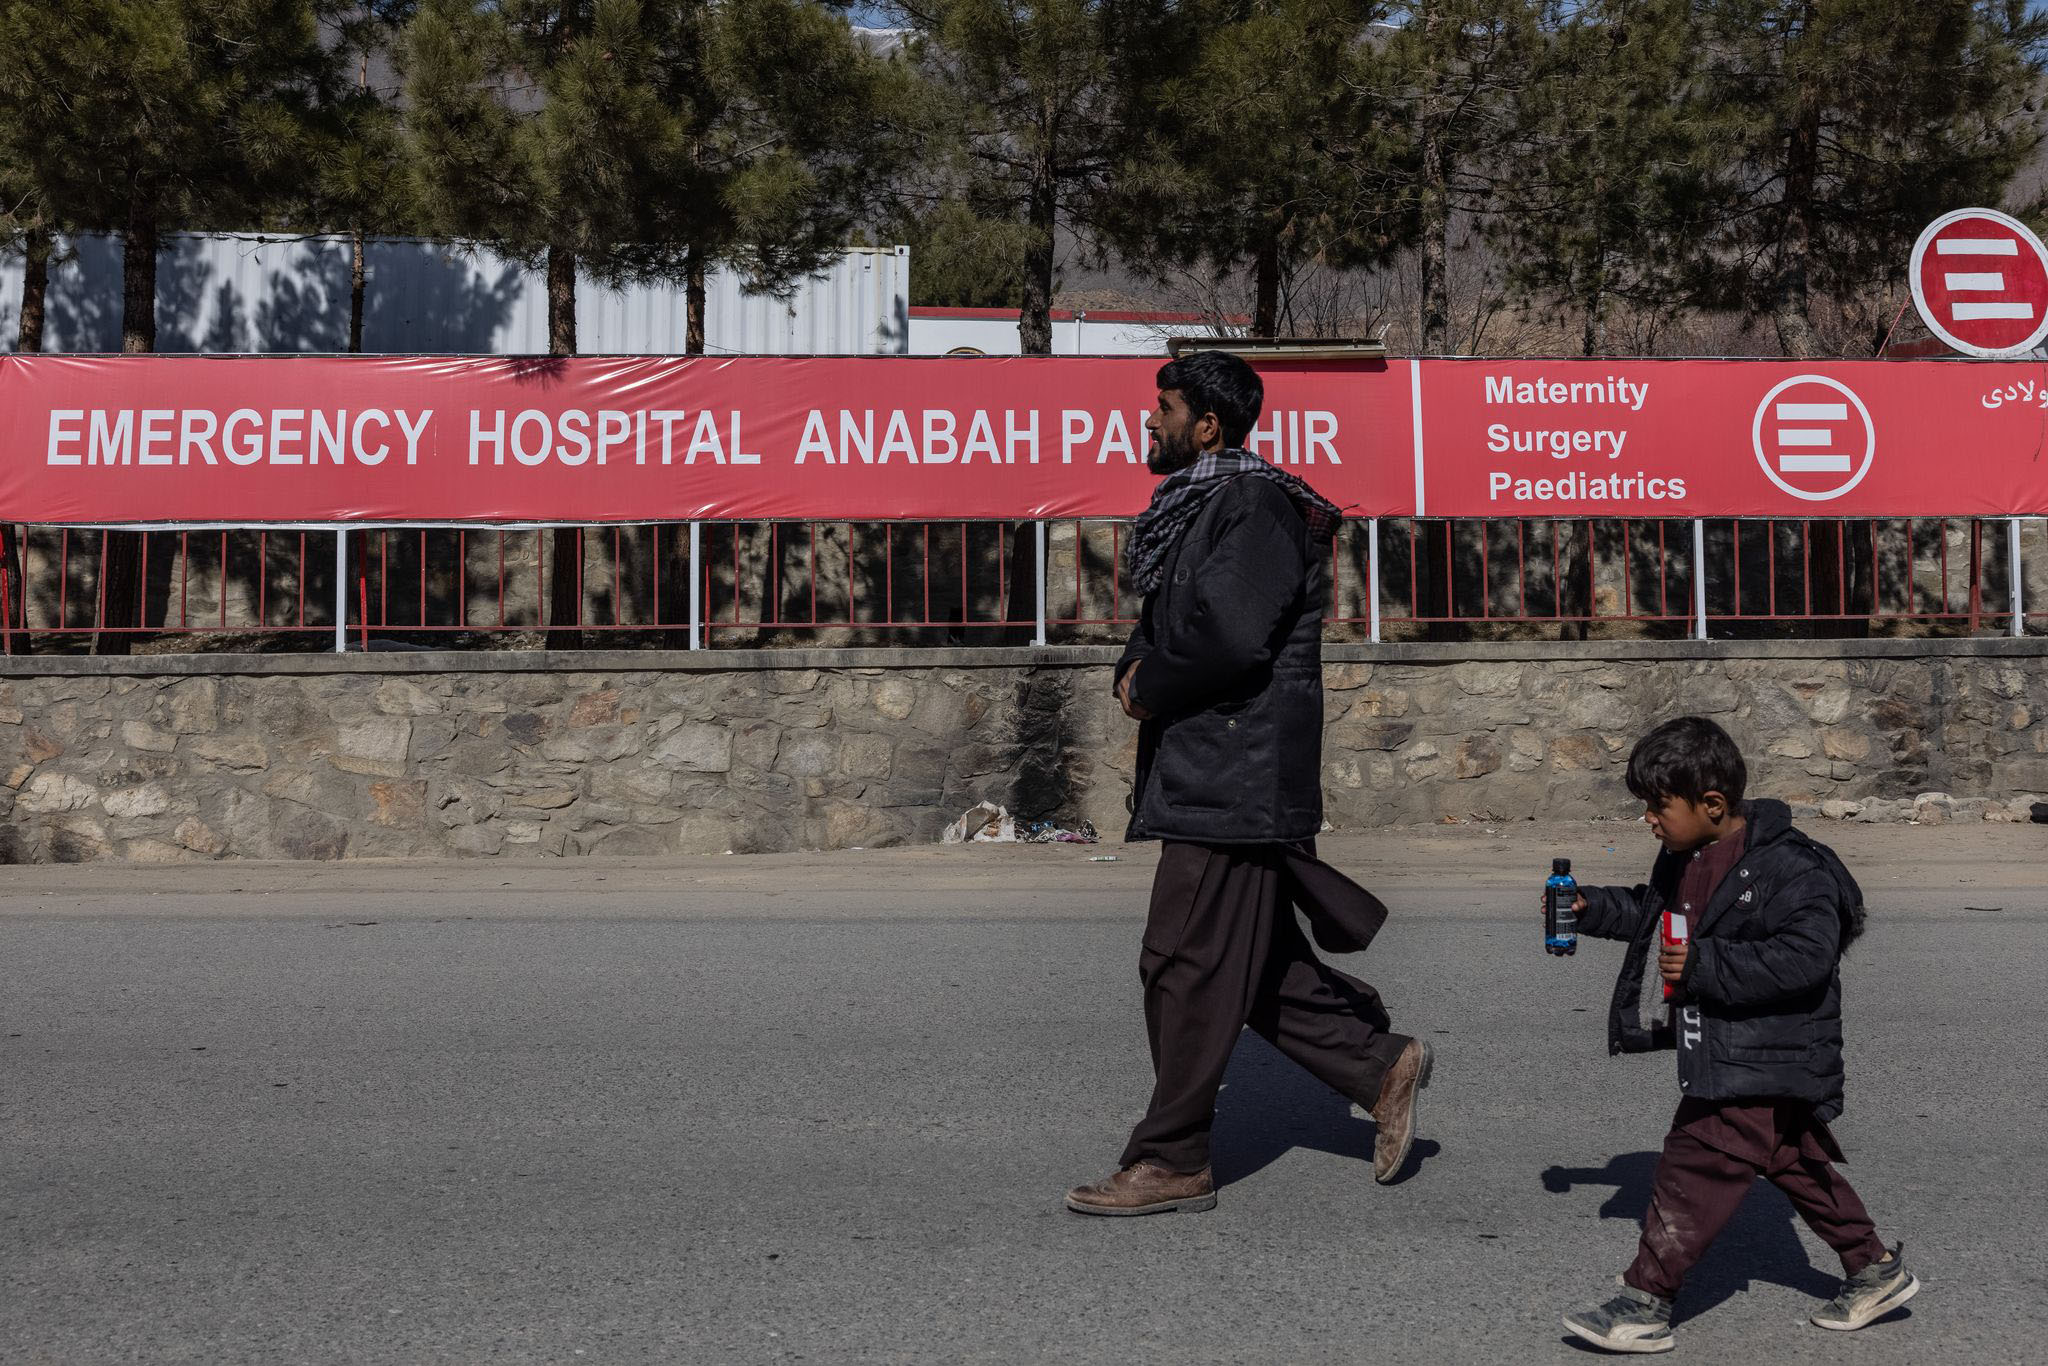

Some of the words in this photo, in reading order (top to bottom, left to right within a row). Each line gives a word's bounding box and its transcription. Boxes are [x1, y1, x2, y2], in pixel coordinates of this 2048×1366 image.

[1484, 375, 1649, 411] Maternity
[46, 408, 434, 466] EMERGENCY
[468, 408, 761, 467] HOSPITAL
[793, 409, 1040, 465] ANABAH
[1061, 409, 1343, 465] PAHIR
[1487, 423, 1628, 460] Surgery
[1489, 471, 1687, 501] Paediatrics
